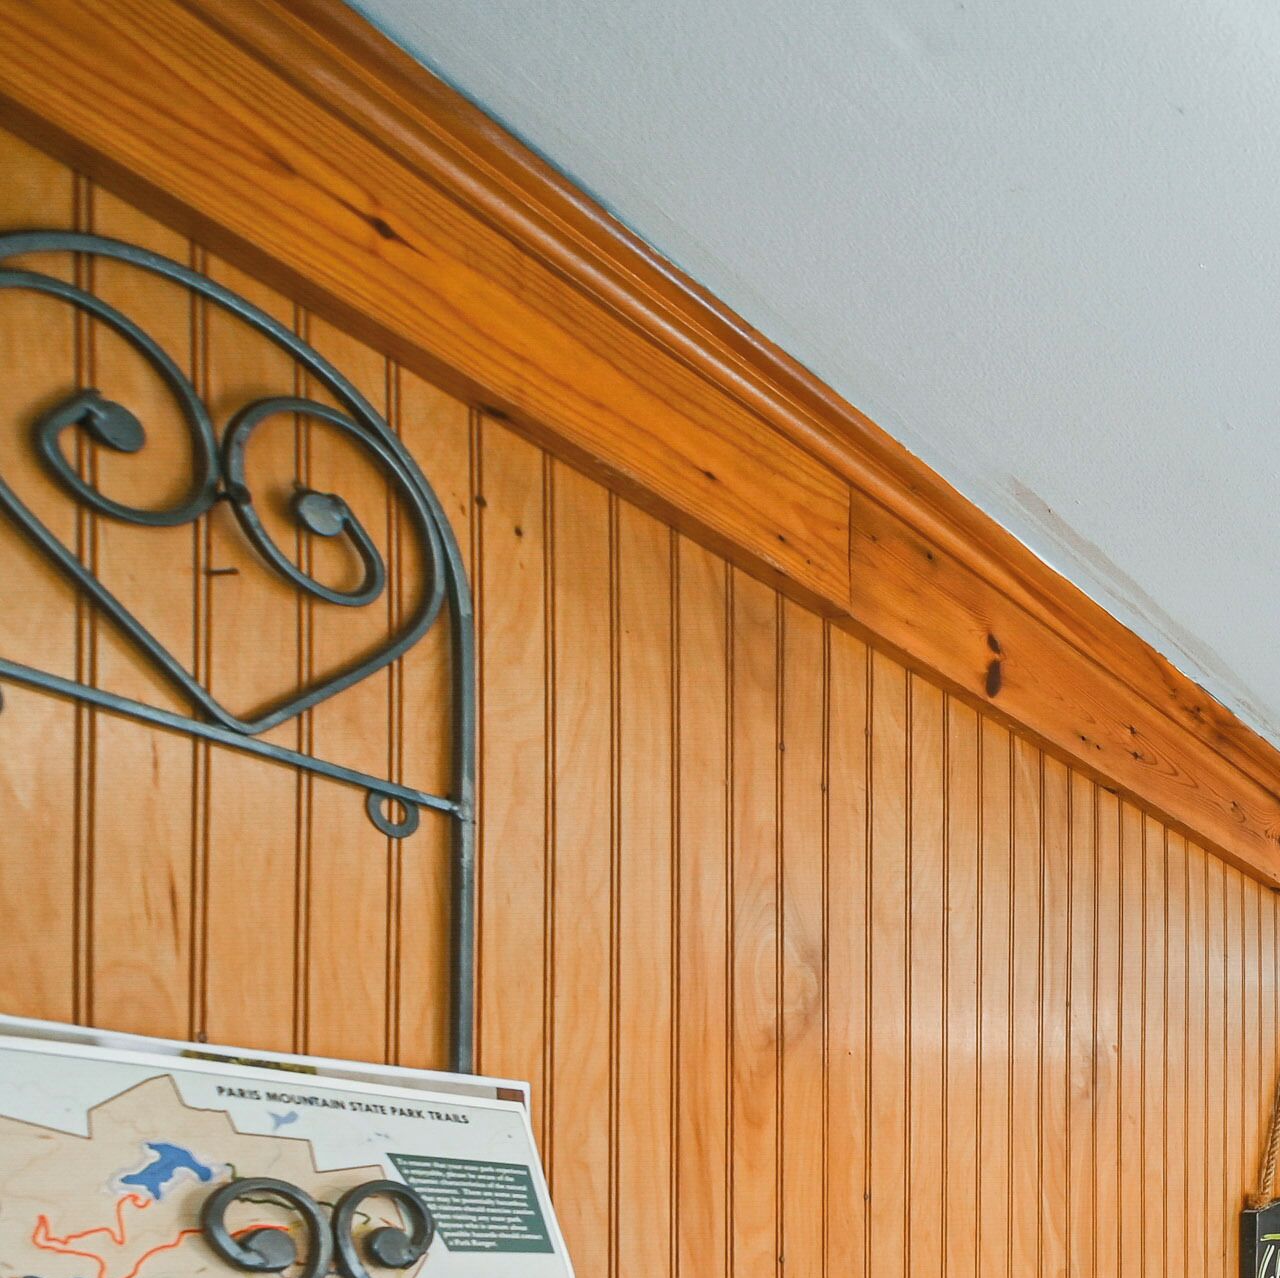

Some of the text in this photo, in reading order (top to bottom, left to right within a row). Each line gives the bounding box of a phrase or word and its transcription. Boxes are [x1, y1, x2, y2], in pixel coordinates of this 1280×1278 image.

[216, 1085, 470, 1125] PARIS MOUNTAIN STATE PARK TRAILS
